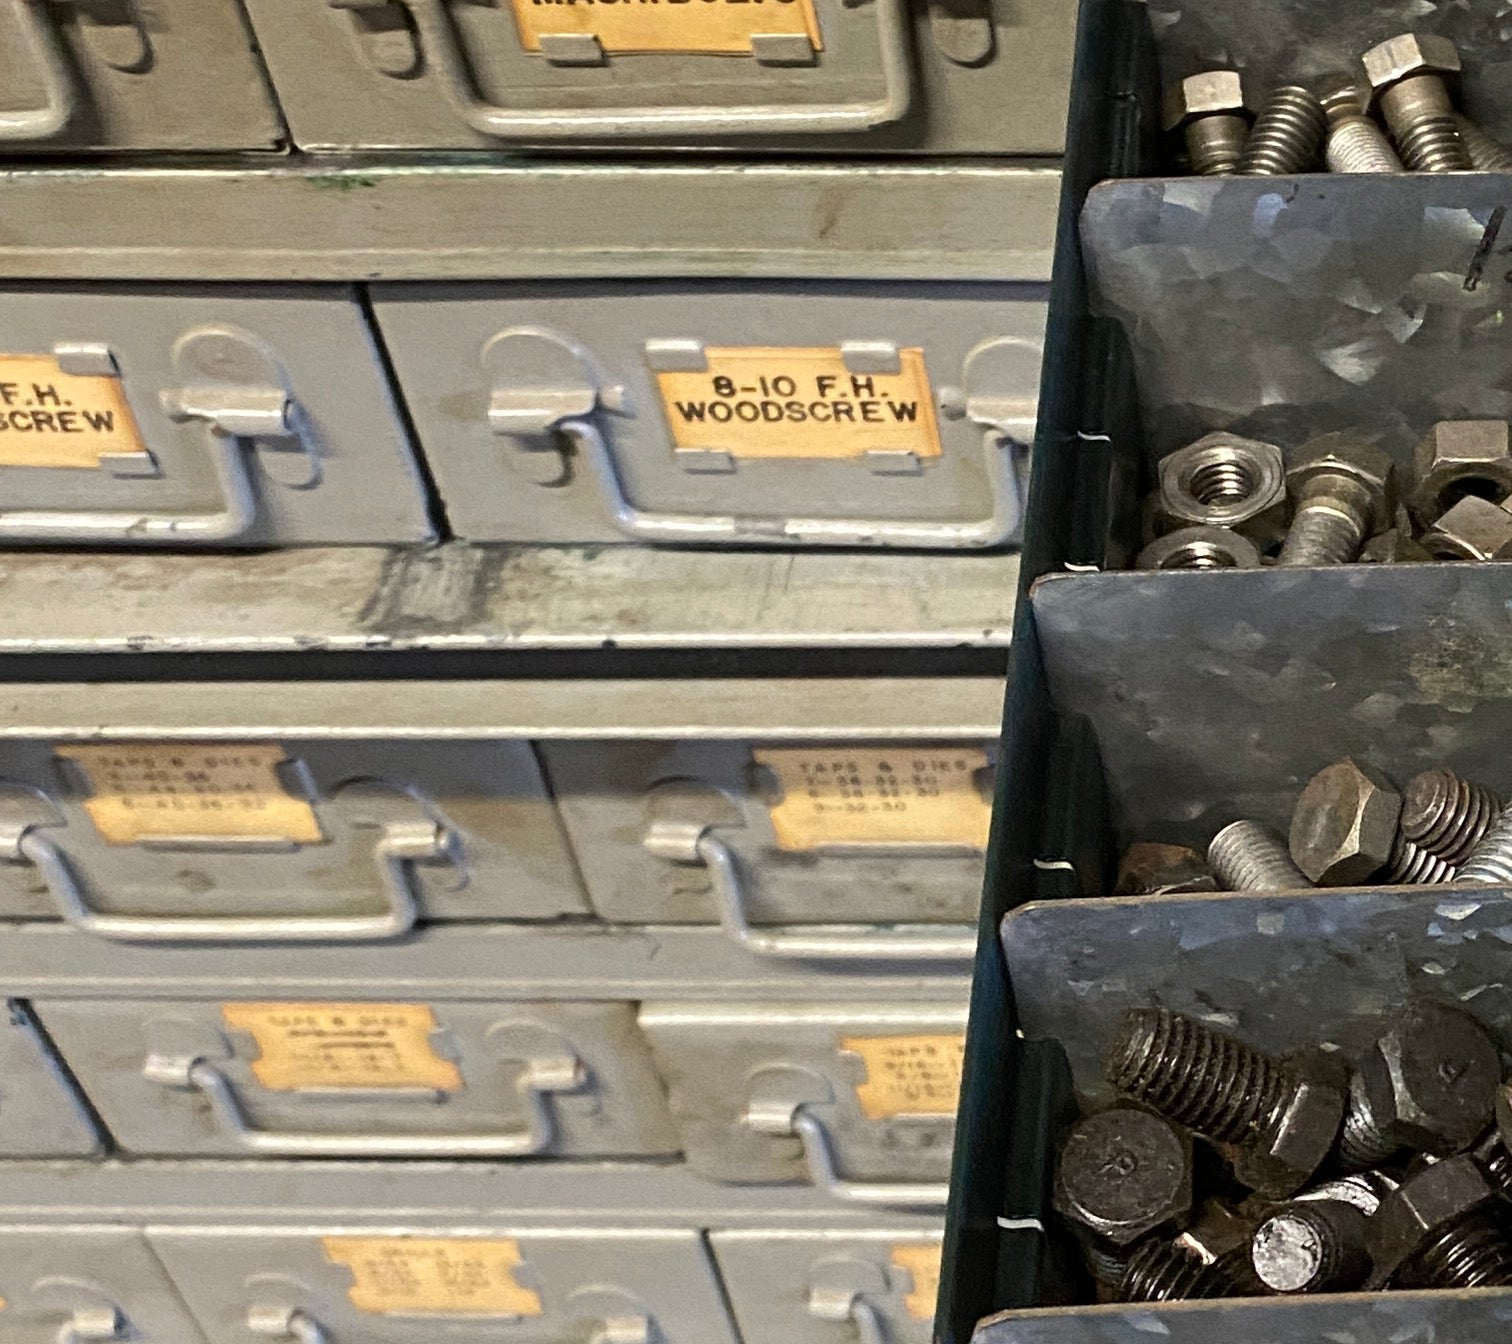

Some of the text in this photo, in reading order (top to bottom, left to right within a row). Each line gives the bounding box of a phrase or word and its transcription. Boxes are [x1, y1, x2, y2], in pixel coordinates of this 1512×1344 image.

[711, 376, 890, 398] 8-10 F.H.
[674, 400, 919, 423] WOODSCREW
